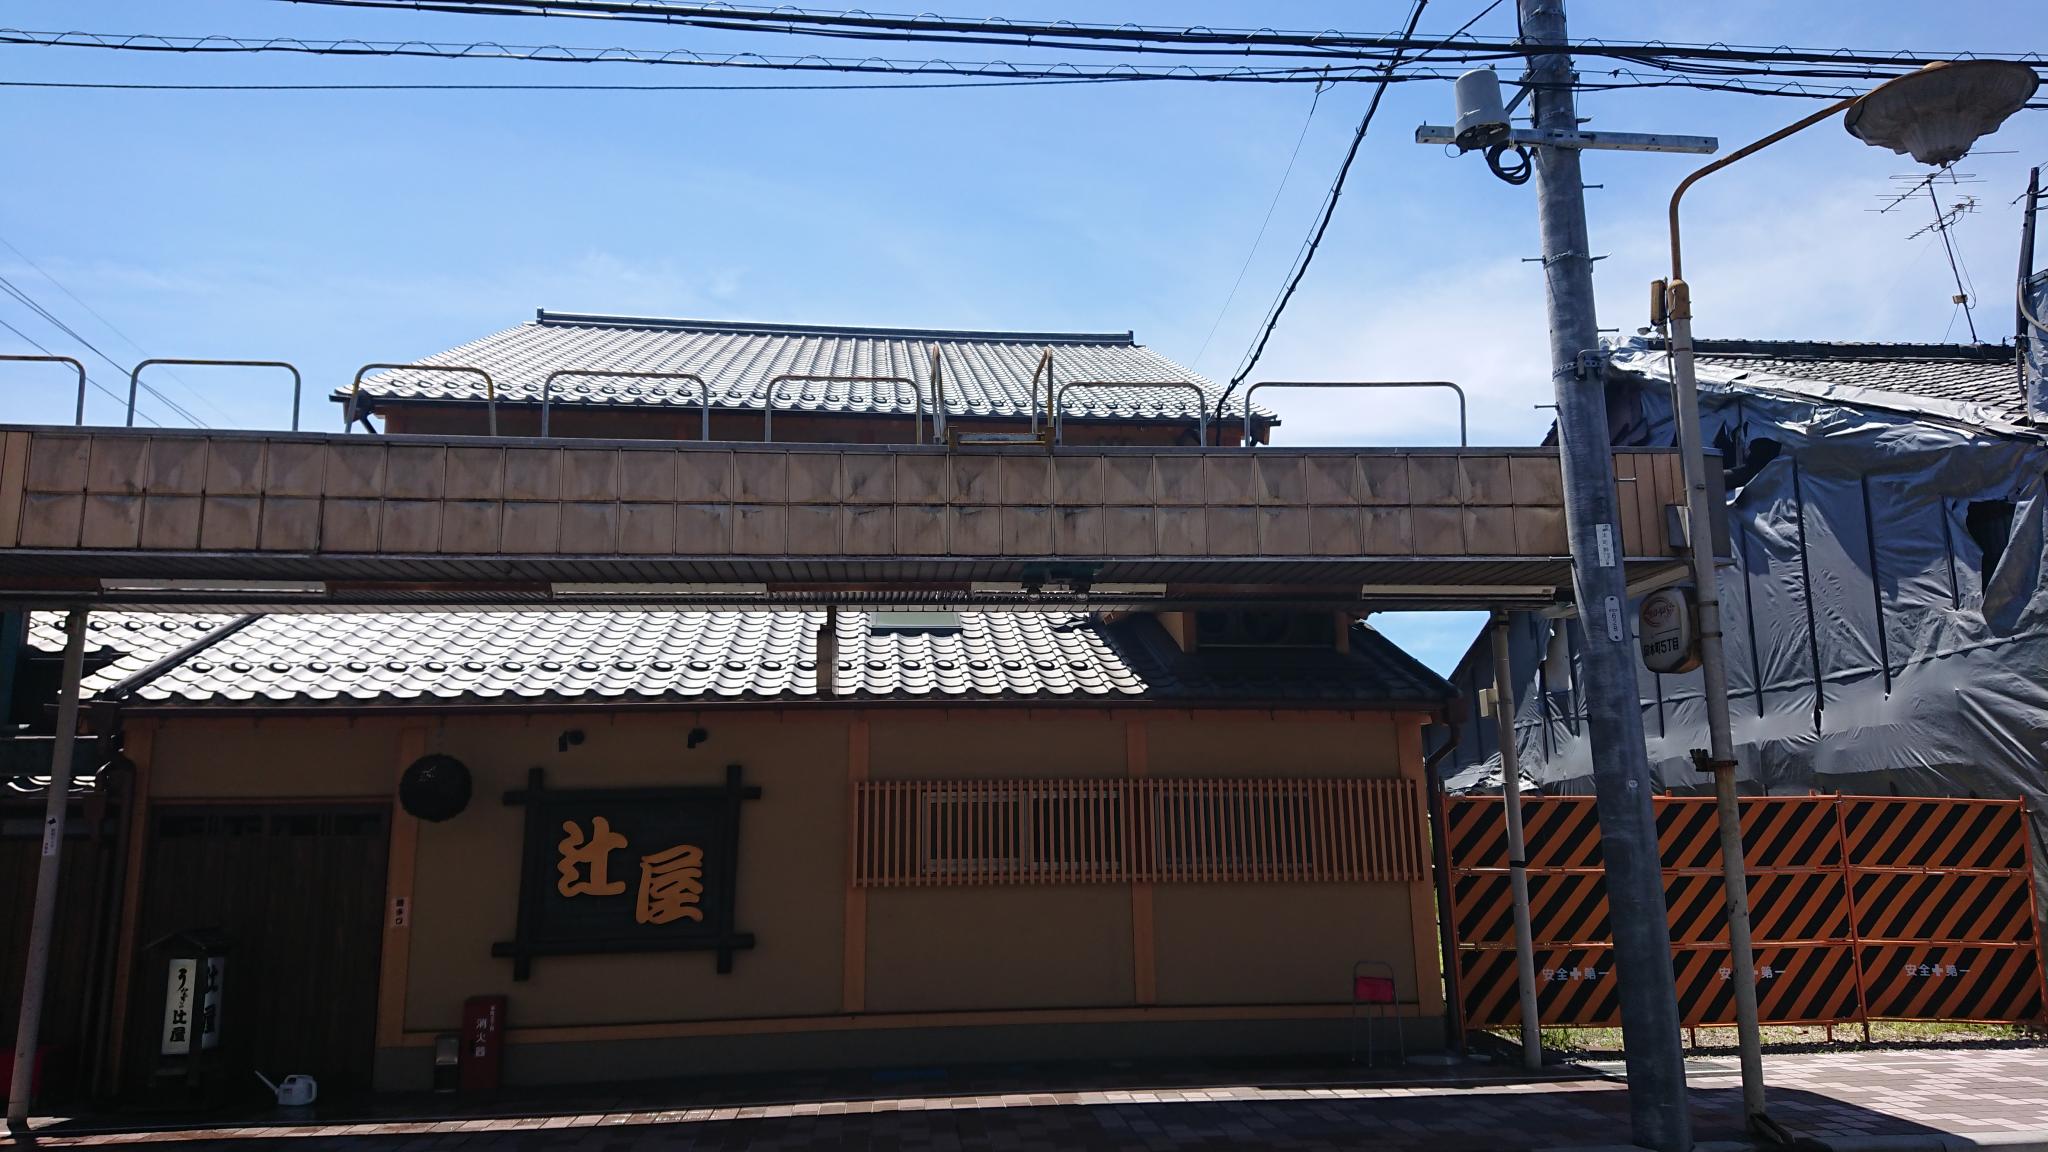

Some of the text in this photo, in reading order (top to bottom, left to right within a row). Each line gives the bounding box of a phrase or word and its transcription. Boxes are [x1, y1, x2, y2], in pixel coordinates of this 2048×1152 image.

[556, 815, 704, 926] 辻屋
[475, 1017, 488, 1057] 消火器
